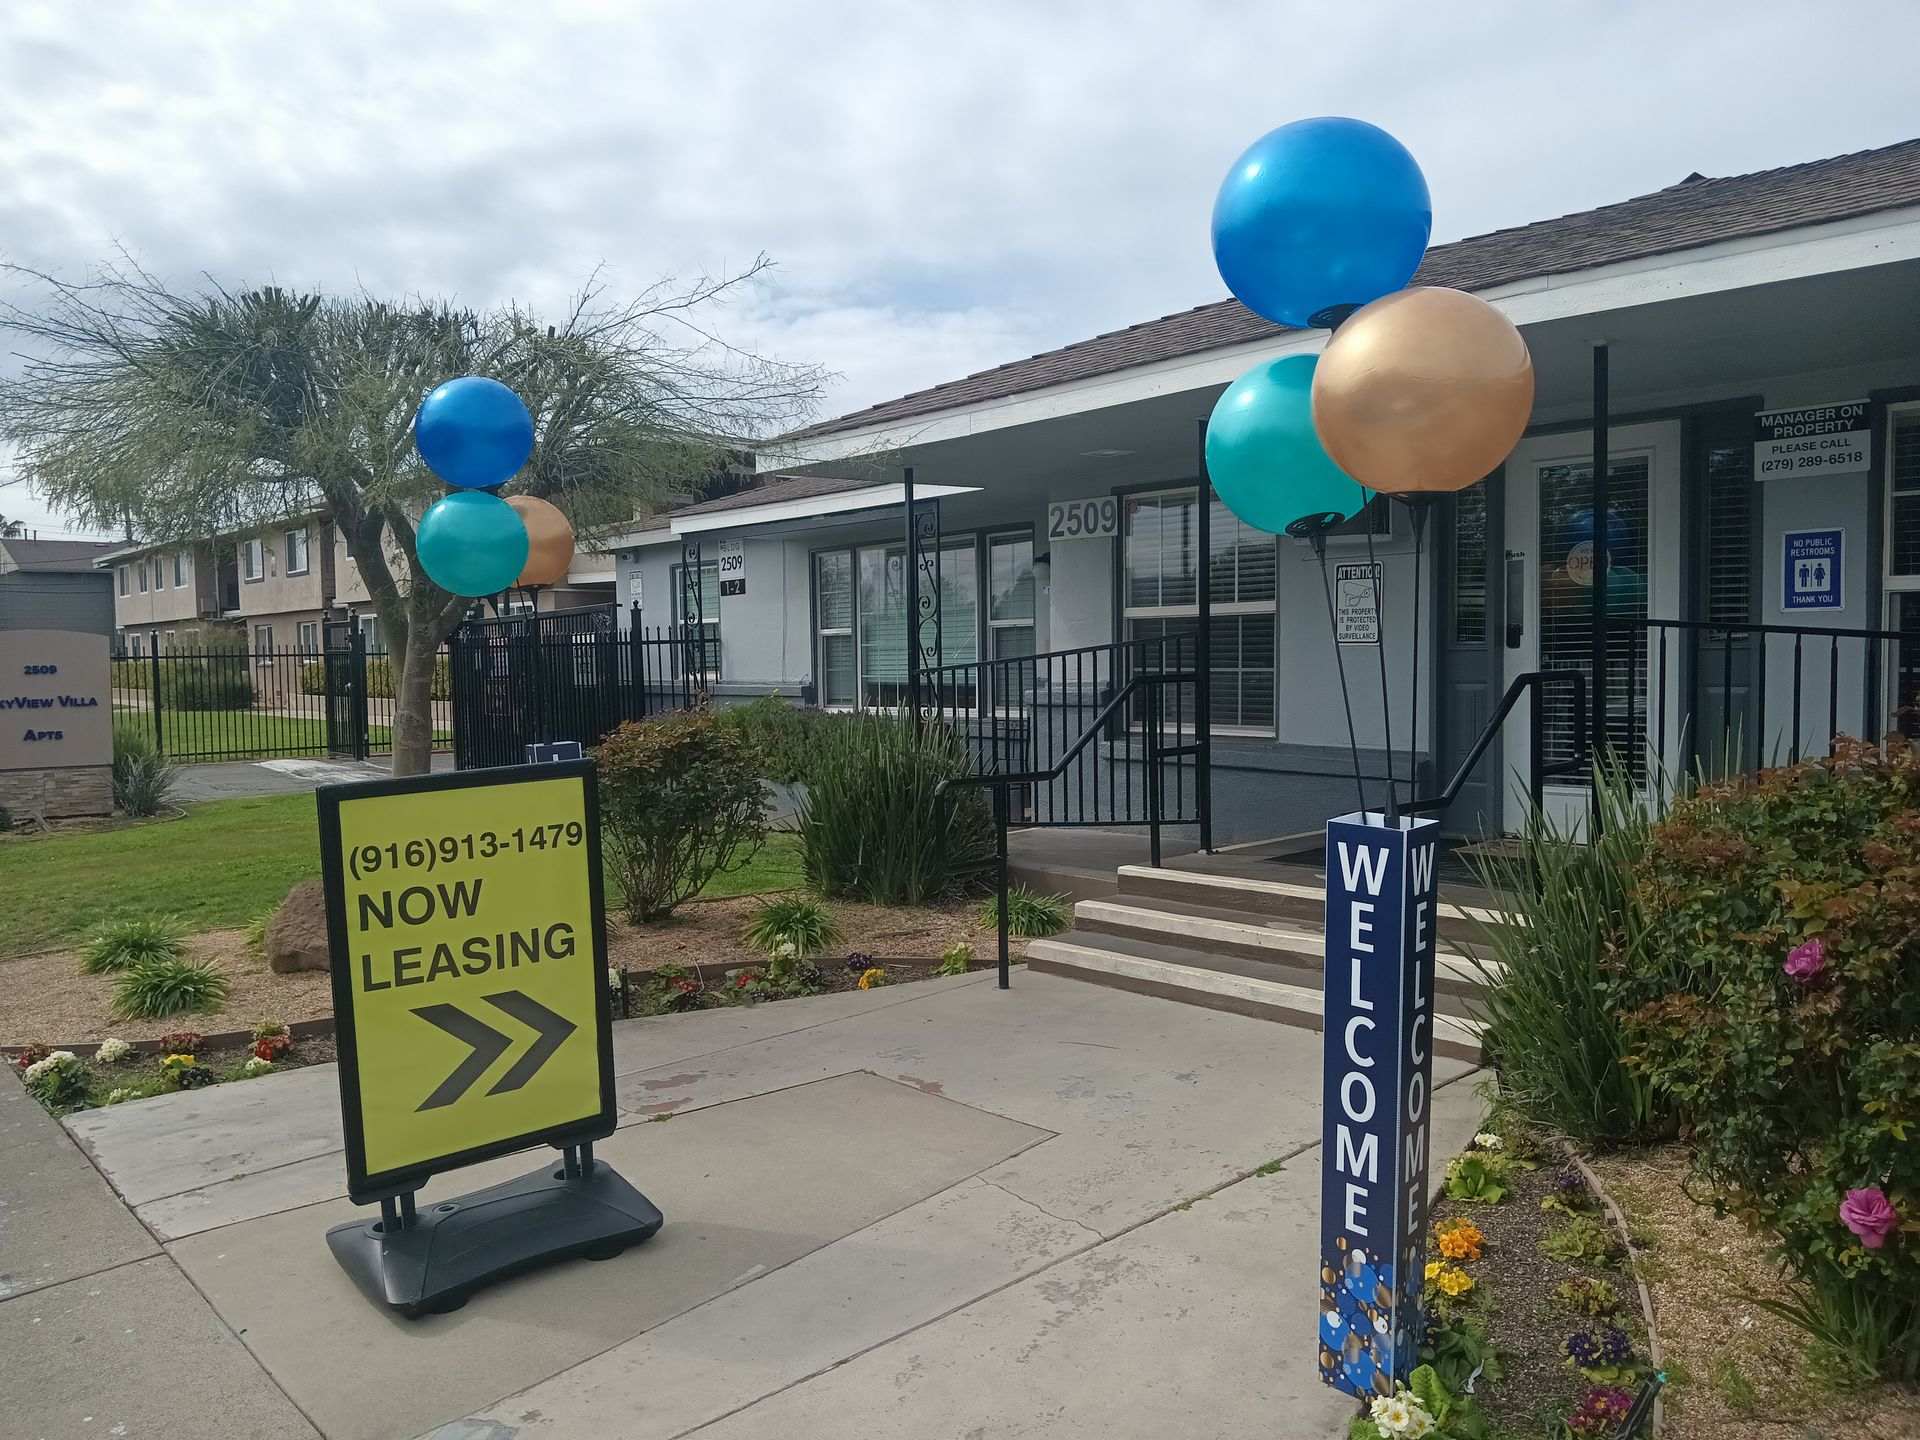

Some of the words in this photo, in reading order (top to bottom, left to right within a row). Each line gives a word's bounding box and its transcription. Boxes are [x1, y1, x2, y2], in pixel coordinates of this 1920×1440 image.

[1761, 408, 1836, 428] MANAGER
[1840, 404, 1864, 418] ON
[1774, 418, 1855, 438] PROPERTY
[1771, 441, 1817, 455] PLEASE
[1820, 438, 1852, 450] CALL
[1761, 458, 1794, 473] (279)
[1799, 451, 1863, 468] 289-6518
[1050, 501, 1117, 537] 2509
[1791, 546, 1835, 557] RESTROOMS
[1793, 539, 1803, 548] NO
[1805, 537, 1833, 547] PUBLIC
[721, 554, 743, 571] 2509
[1337, 565, 1380, 579] ATTENTIO!
[725, 580, 741, 595] 1-2
[1792, 595, 1816, 604] THANK
[1818, 594, 1833, 603] YOU
[23, 665, 57, 675] 2509
[350, 822, 583, 881] (916)913-1479
[358, 878, 483, 931] NOW
[362, 922, 575, 993] LEASING
[1336, 841, 1389, 1237] WELCOME
[1404, 841, 1435, 1236] WELCOME
